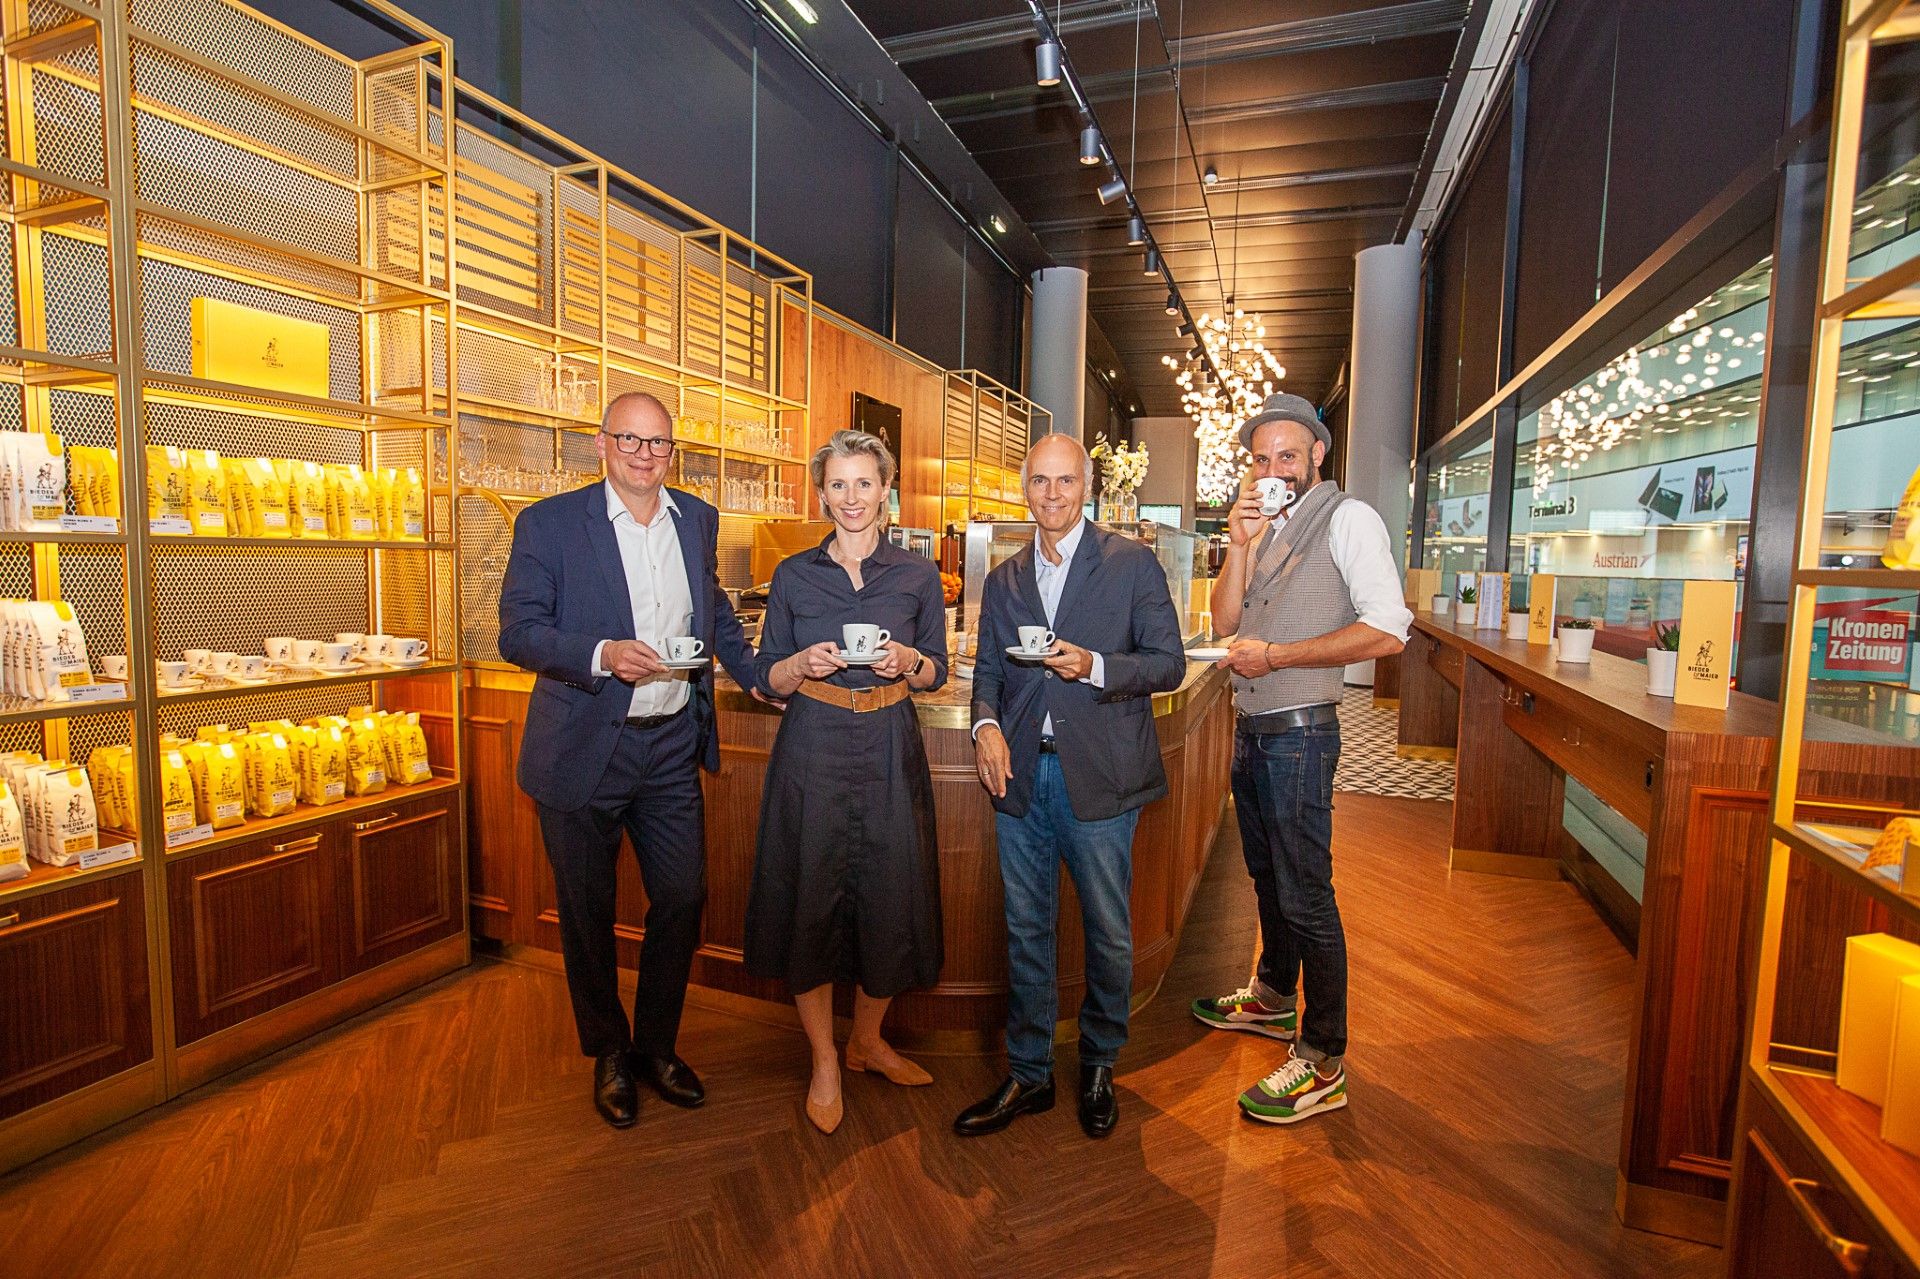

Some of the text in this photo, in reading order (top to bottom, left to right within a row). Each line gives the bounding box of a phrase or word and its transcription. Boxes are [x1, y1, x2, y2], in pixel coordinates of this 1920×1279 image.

[1529, 496, 1575, 518] Terminal 3
[1593, 552, 1638, 568] Austrian
[1831, 617, 1905, 640] Kronen
[1829, 640, 1903, 664] Zeitung
[1687, 665, 1710, 673] BIEDER
